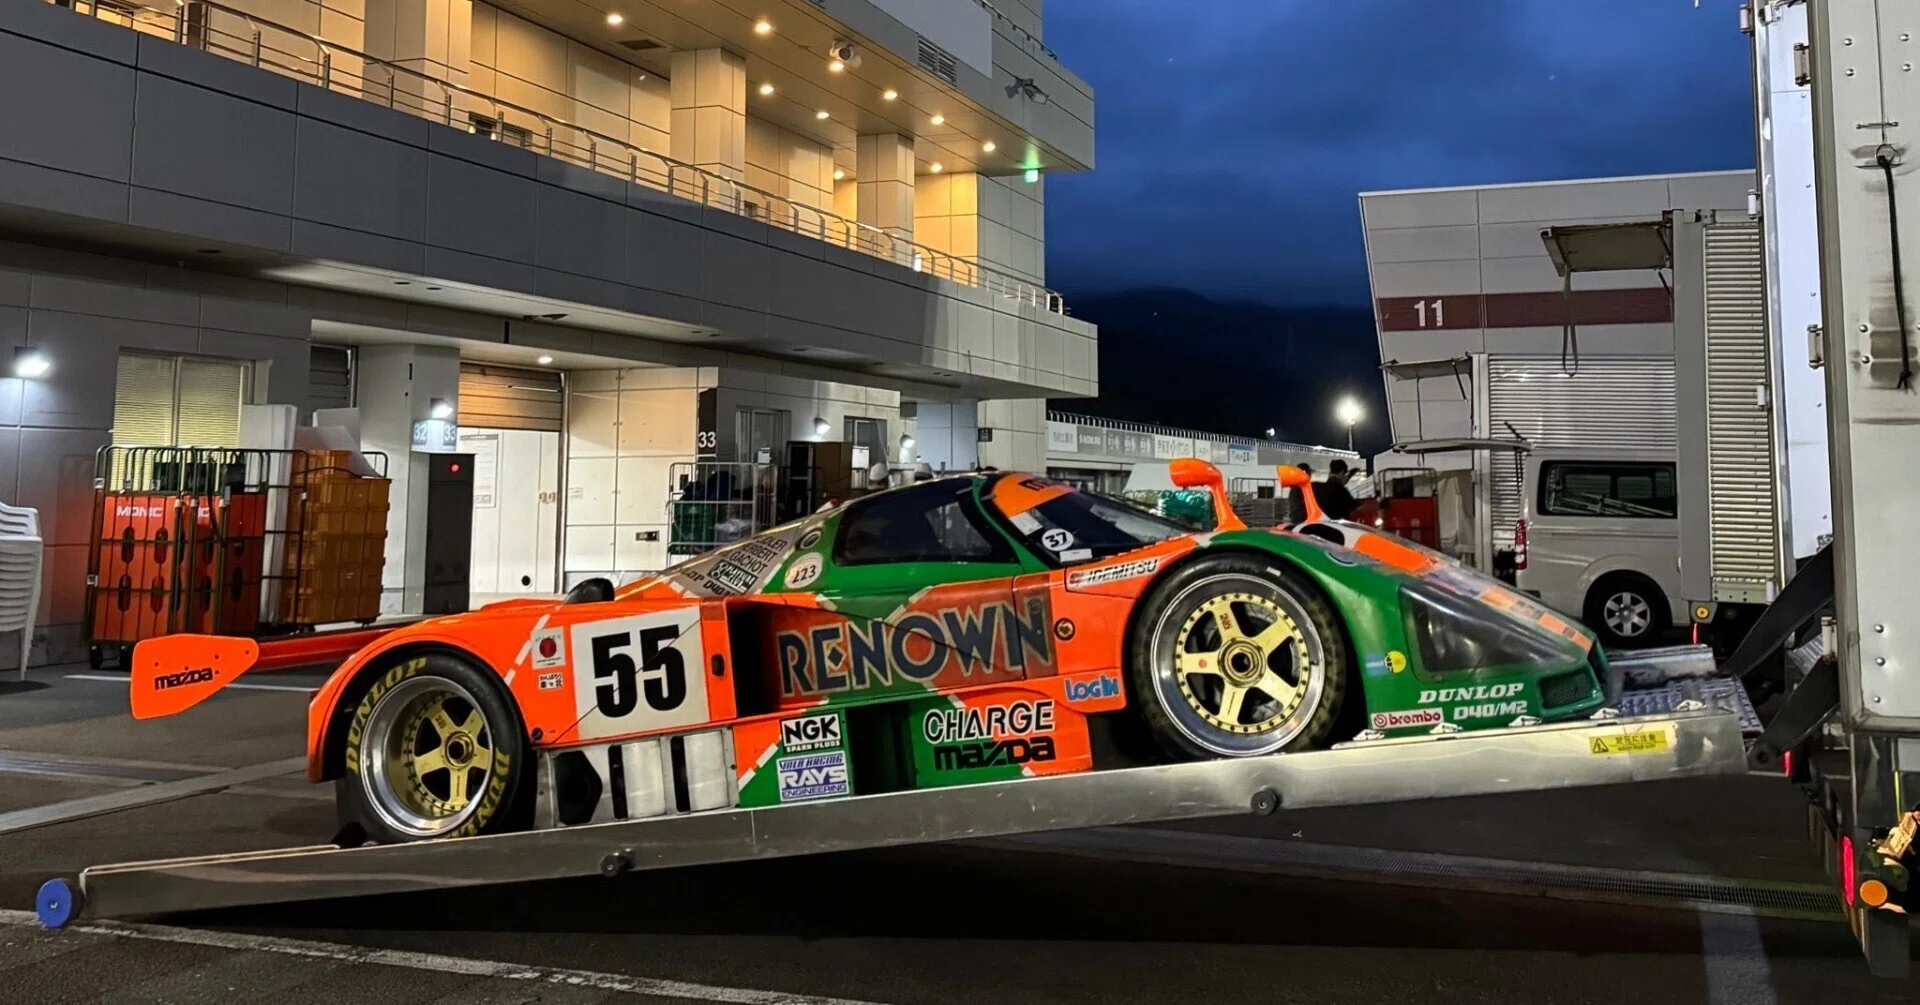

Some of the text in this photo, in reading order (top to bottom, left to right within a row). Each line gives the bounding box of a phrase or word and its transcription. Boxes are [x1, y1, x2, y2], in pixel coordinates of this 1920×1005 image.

[1414, 300, 1443, 327] 11
[413, 424, 427, 441] 32
[443, 424, 457, 441] 33
[698, 431, 716, 448] 33
[1044, 531, 1068, 548] 37
[729, 551, 768, 575] GACHOT
[1088, 560, 1158, 582] IDEMITSU
[777, 594, 1053, 698] RENOWN
[591, 624, 687, 718] 55
[1418, 683, 1524, 704] DUNLOP
[346, 657, 428, 775] DUNLOP
[1389, 711, 1441, 725] brembo
[1453, 700, 1528, 721] D40/M2
[783, 716, 839, 744] NGK
[923, 700, 1056, 744] CHARGE
[780, 767, 846, 790] RAYS
[782, 784, 847, 799] ENGINEERING
